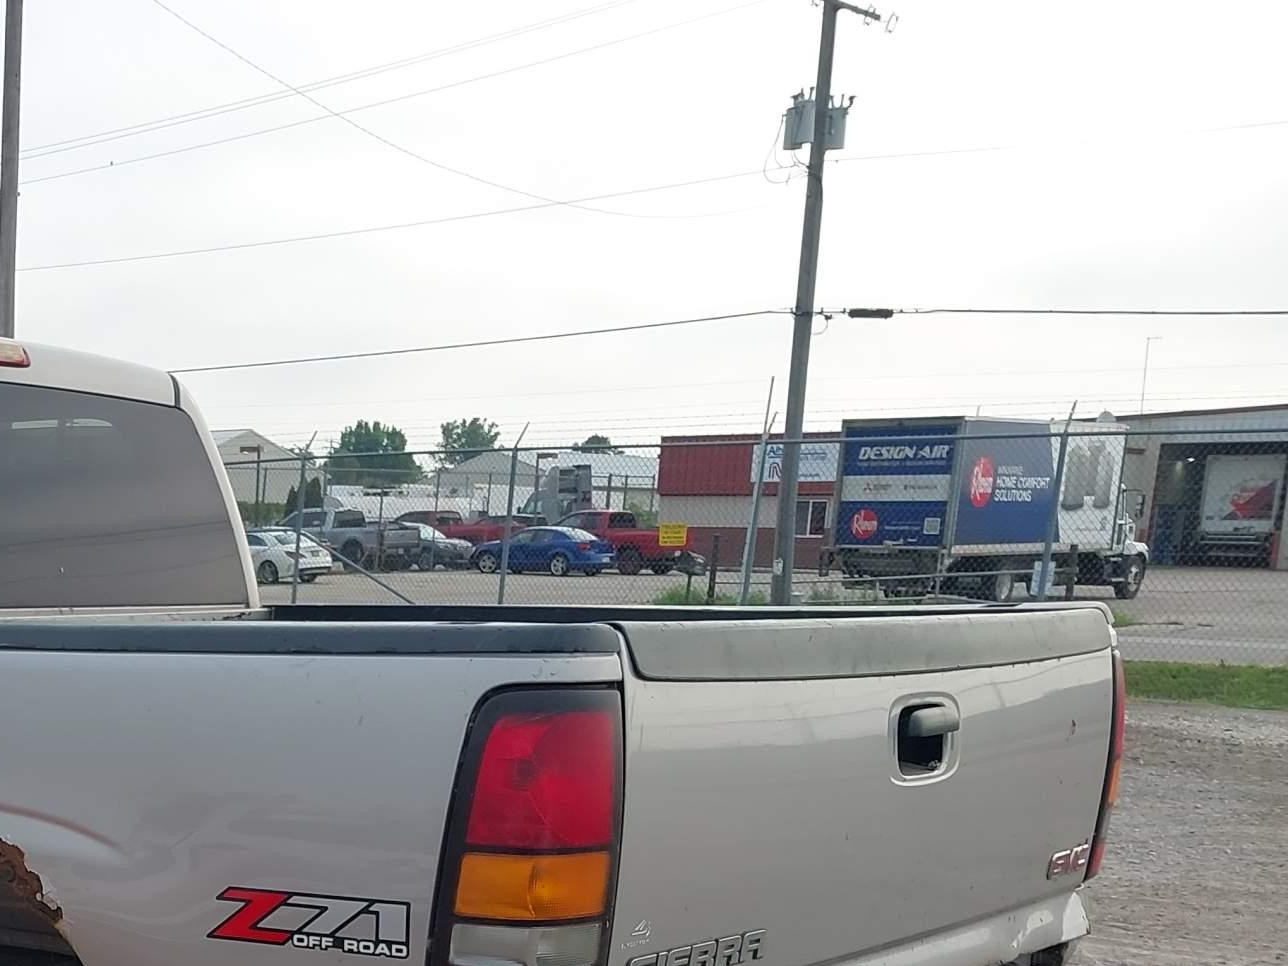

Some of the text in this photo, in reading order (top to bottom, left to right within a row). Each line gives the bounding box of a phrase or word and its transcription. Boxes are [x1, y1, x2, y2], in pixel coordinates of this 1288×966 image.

[858, 445, 950, 460] DESIGN AIR
[996, 476, 1051, 489] HOME COMFORT
[994, 489, 1032, 502] SOLUTIONS
[206, 886, 411, 946] Z71
[292, 933, 408, 958] OFF ROAD
